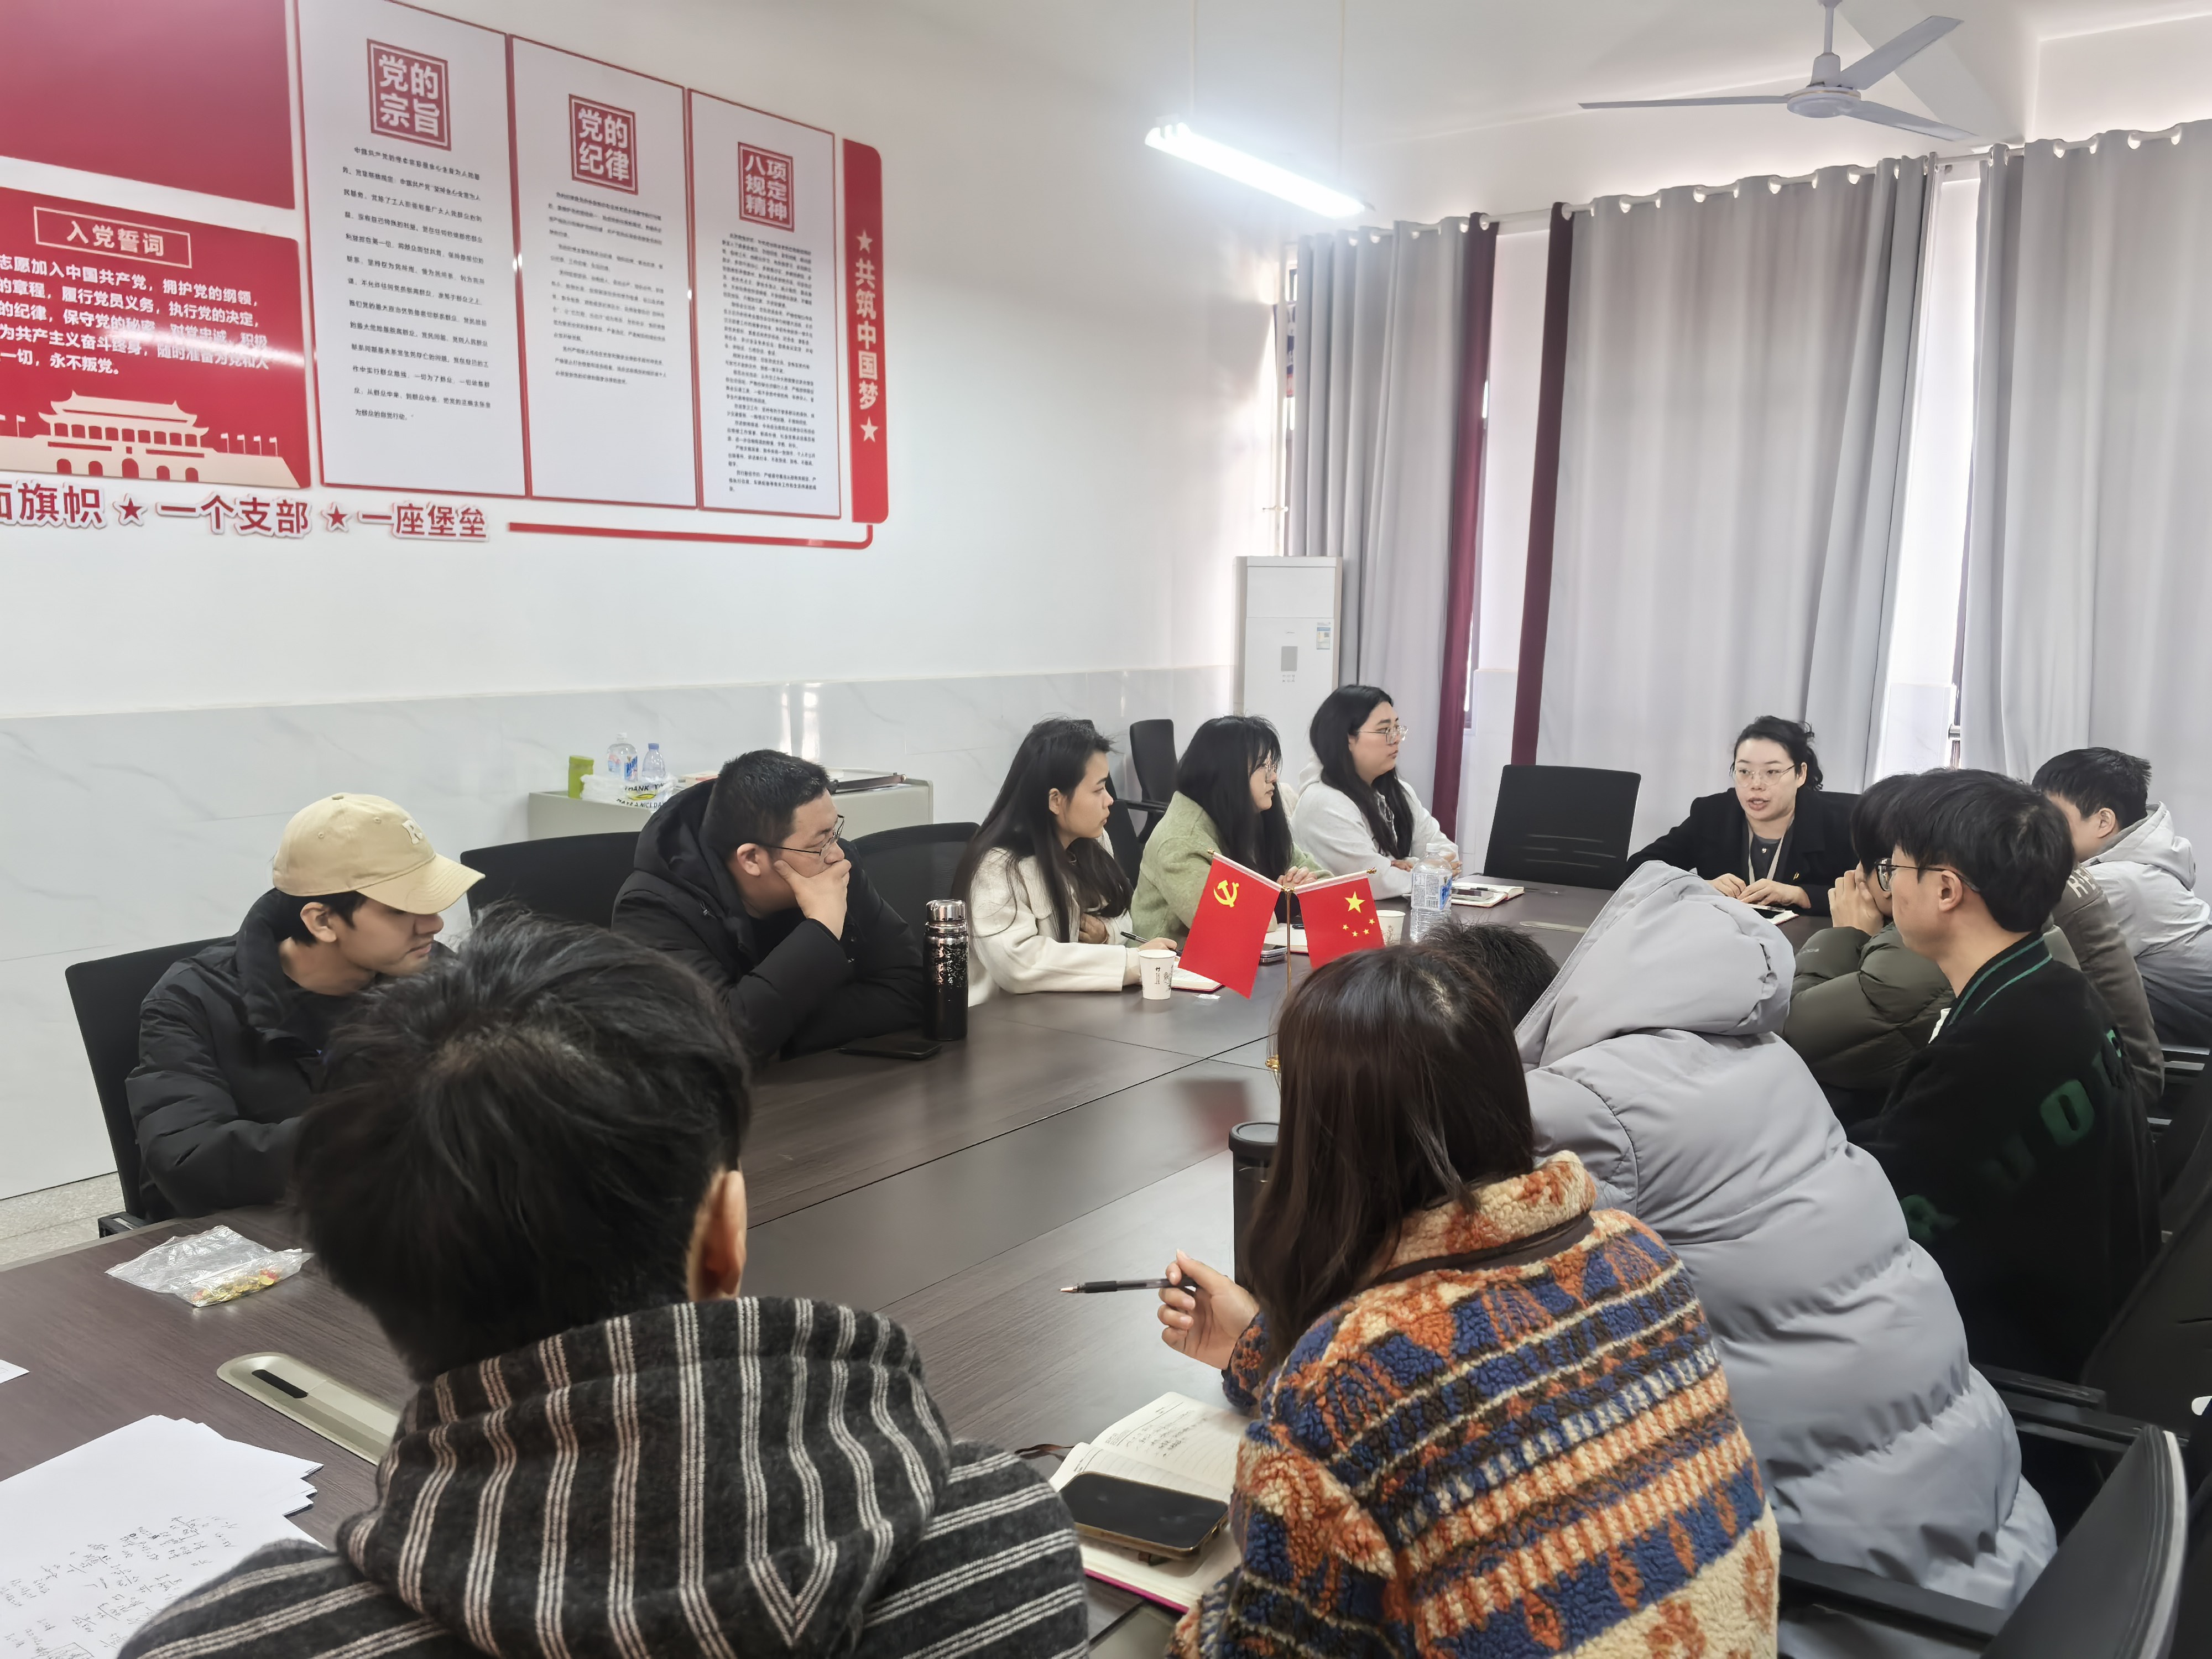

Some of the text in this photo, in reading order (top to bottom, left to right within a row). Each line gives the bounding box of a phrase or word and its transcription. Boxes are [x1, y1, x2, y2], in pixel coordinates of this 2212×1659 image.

[379, 55, 438, 100] 党的
[380, 93, 440, 137] 宗旨
[578, 108, 628, 149] 党的
[580, 142, 629, 181] 纪律
[745, 155, 786, 182] 八项
[745, 175, 787, 202] 规定
[745, 195, 787, 220] 精神
[67, 221, 163, 256] 入党誓词
[855, 258, 878, 409] 共筑中国梦
[161, 495, 307, 533] 一个支部
[362, 503, 486, 538] 一座堡垒
